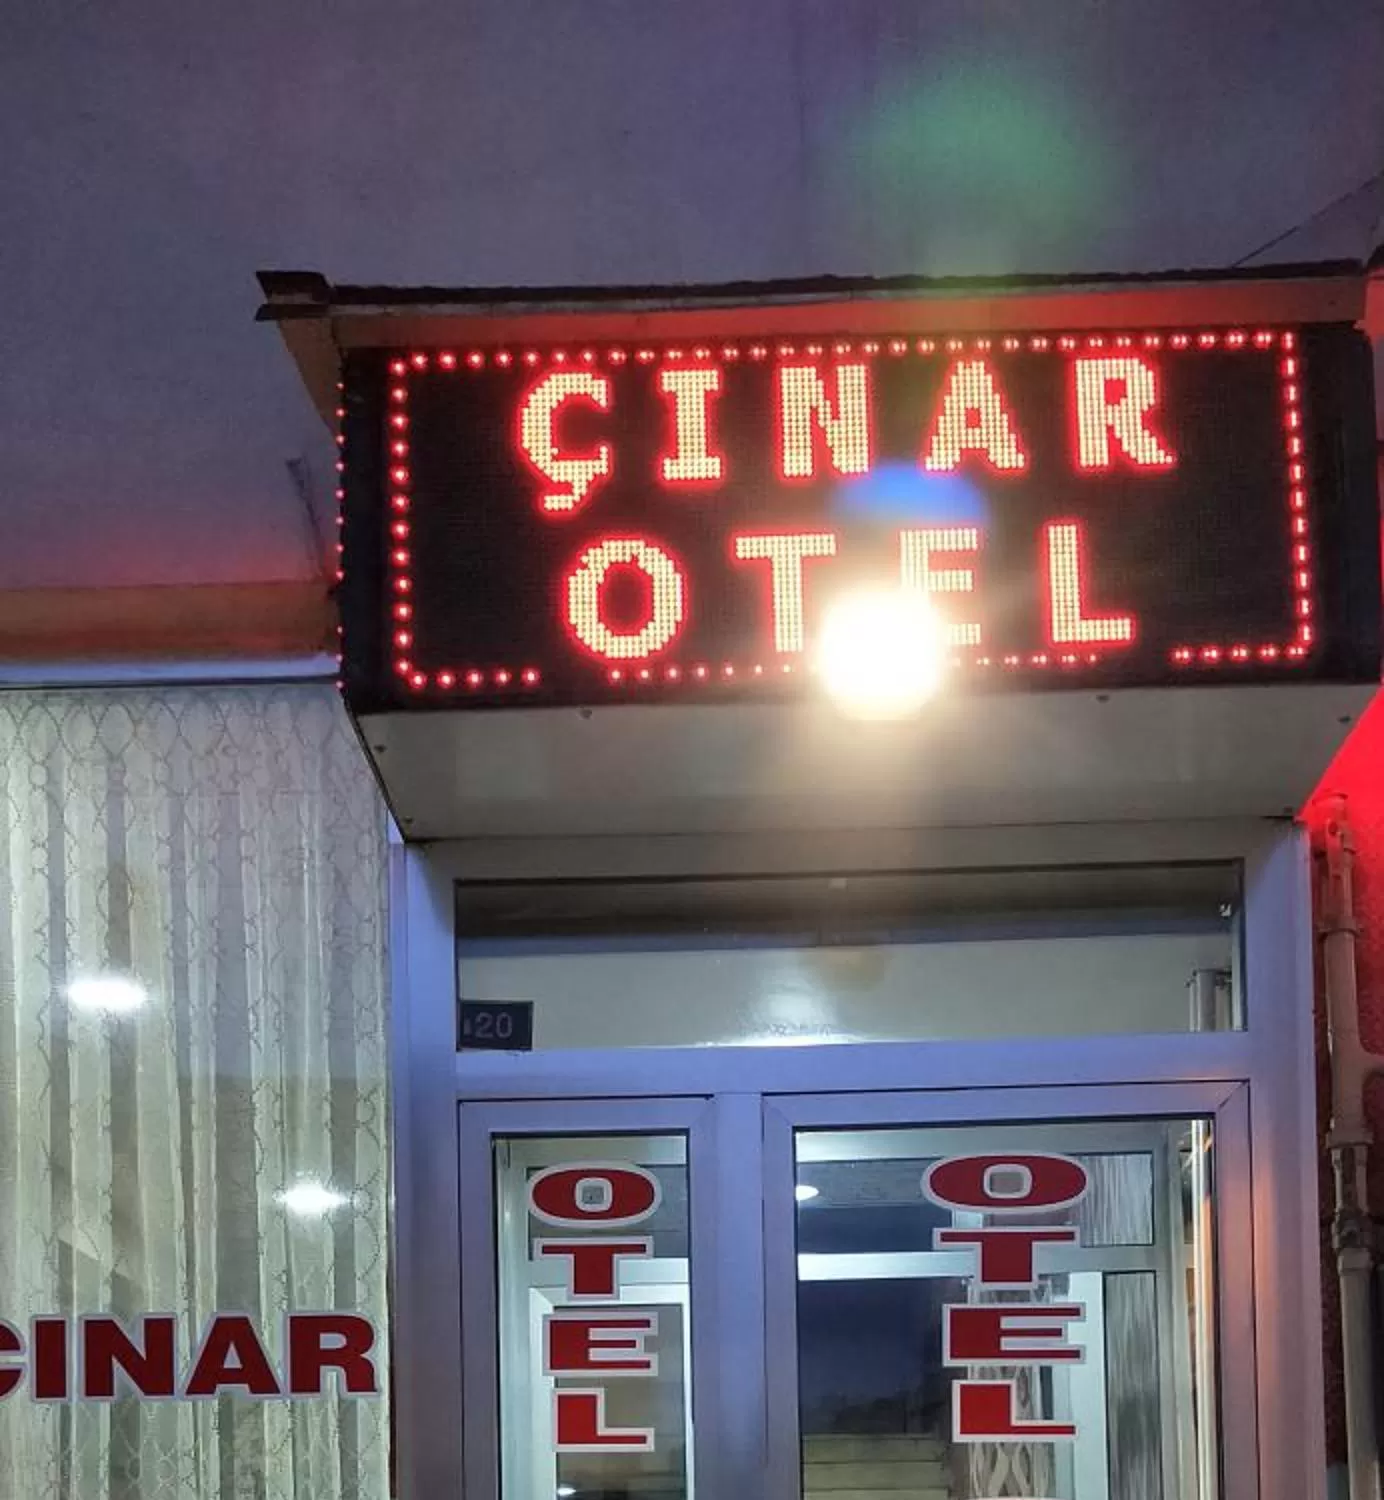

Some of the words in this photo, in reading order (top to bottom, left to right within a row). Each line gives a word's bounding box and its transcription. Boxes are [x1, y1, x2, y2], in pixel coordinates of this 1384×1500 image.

[518, 356, 1178, 512] ÇINAR
[566, 522, 1136, 660] OTEL
[0, 1315, 380, 1400] INAR
[530, 1164, 660, 1450] OTEL
[924, 1153, 1088, 1442] OTEL
